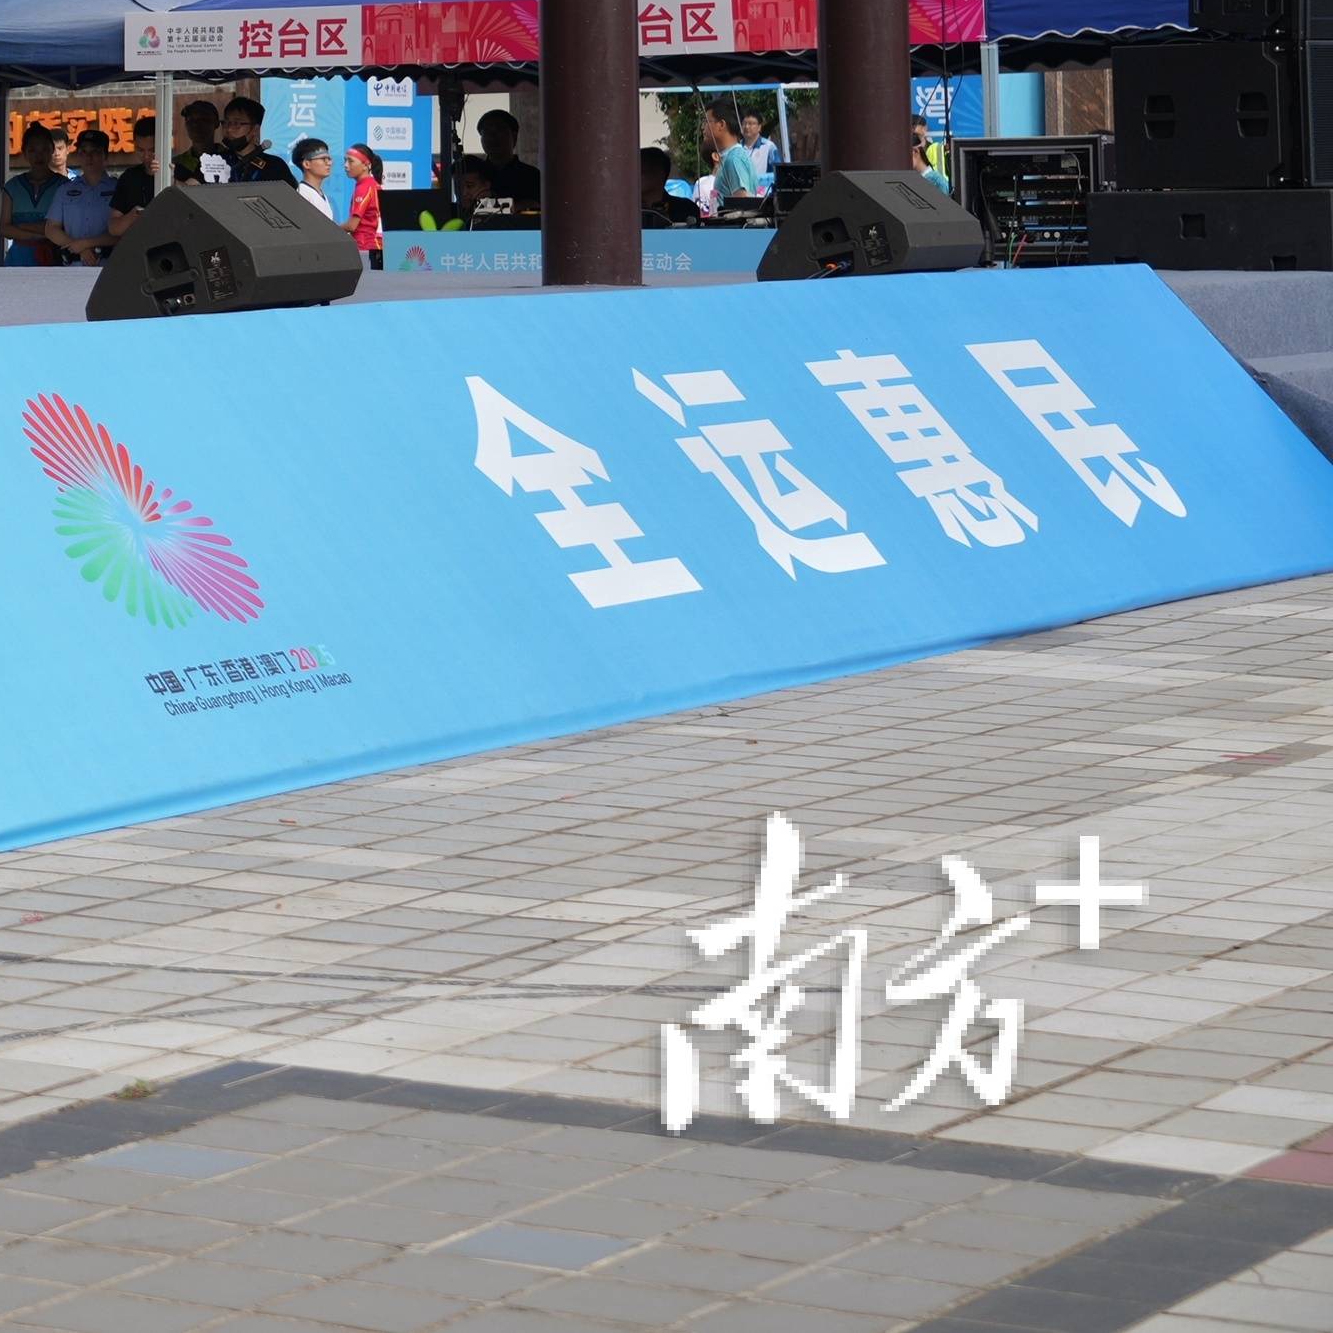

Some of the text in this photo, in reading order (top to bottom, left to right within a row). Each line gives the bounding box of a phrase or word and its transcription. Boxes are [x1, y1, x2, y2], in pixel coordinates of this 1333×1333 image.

[238, 17, 348, 59] 控台区
[637, 2, 718, 45] 台区
[464, 339, 1187, 609] 全运惠民
[256, 683, 292, 699] Hong
[284, 678, 318, 695] Kong
[316, 672, 352, 688] Macao
